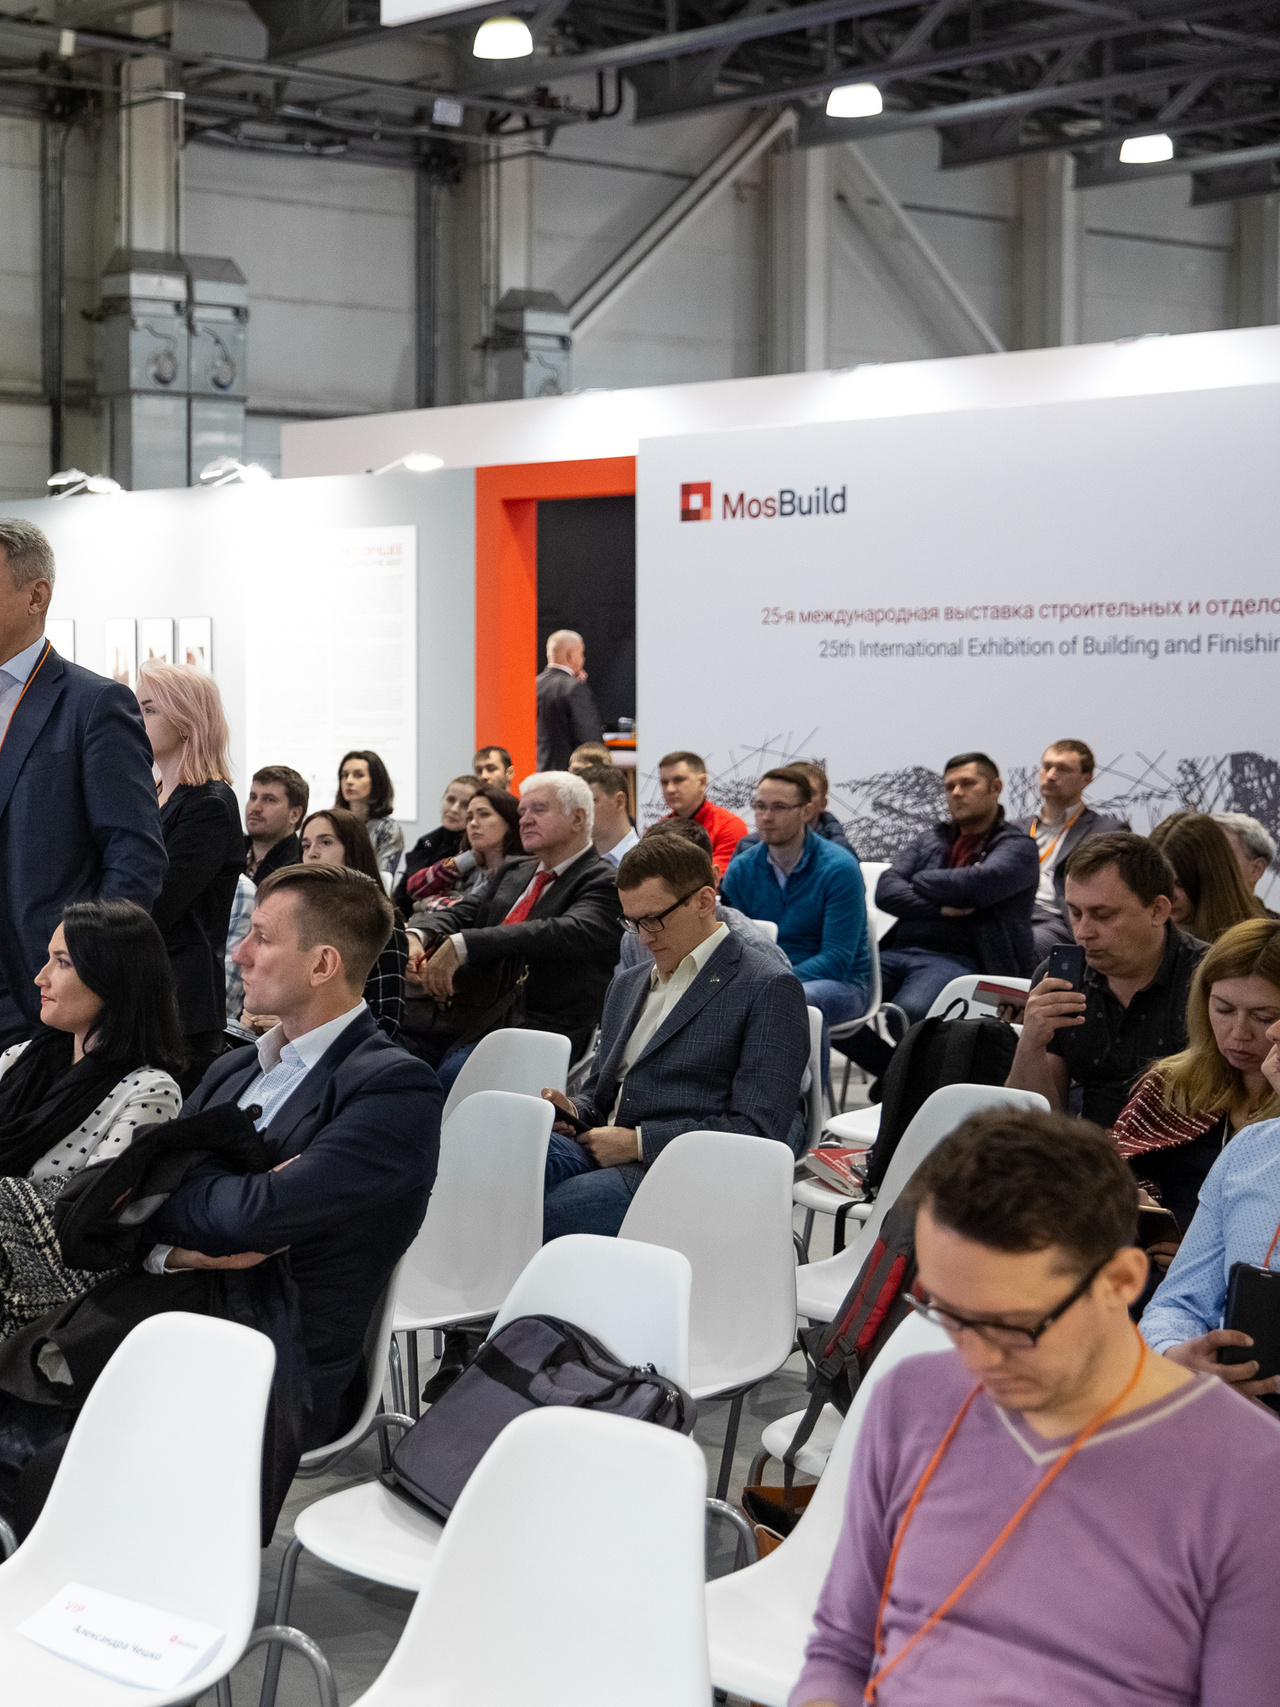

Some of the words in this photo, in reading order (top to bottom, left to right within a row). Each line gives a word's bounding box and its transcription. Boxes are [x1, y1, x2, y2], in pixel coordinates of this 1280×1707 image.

[722, 484, 847, 520] MosBuild
[761, 606, 795, 625] 25-я
[799, 607, 939, 627] международная
[943, 603, 1035, 621] выставка
[1039, 601, 1182, 623] строительных
[1188, 600, 1201, 615] и
[819, 639, 855, 658] 25th
[859, 637, 964, 658] International
[968, 635, 1055, 658] Exhibition
[1058, 634, 1078, 656] of
[1082, 634, 1159, 660] Building
[1164, 632, 1201, 655] and
[64, 1601, 86, 1613] VIP
[73, 1624, 129, 1651] Александра
